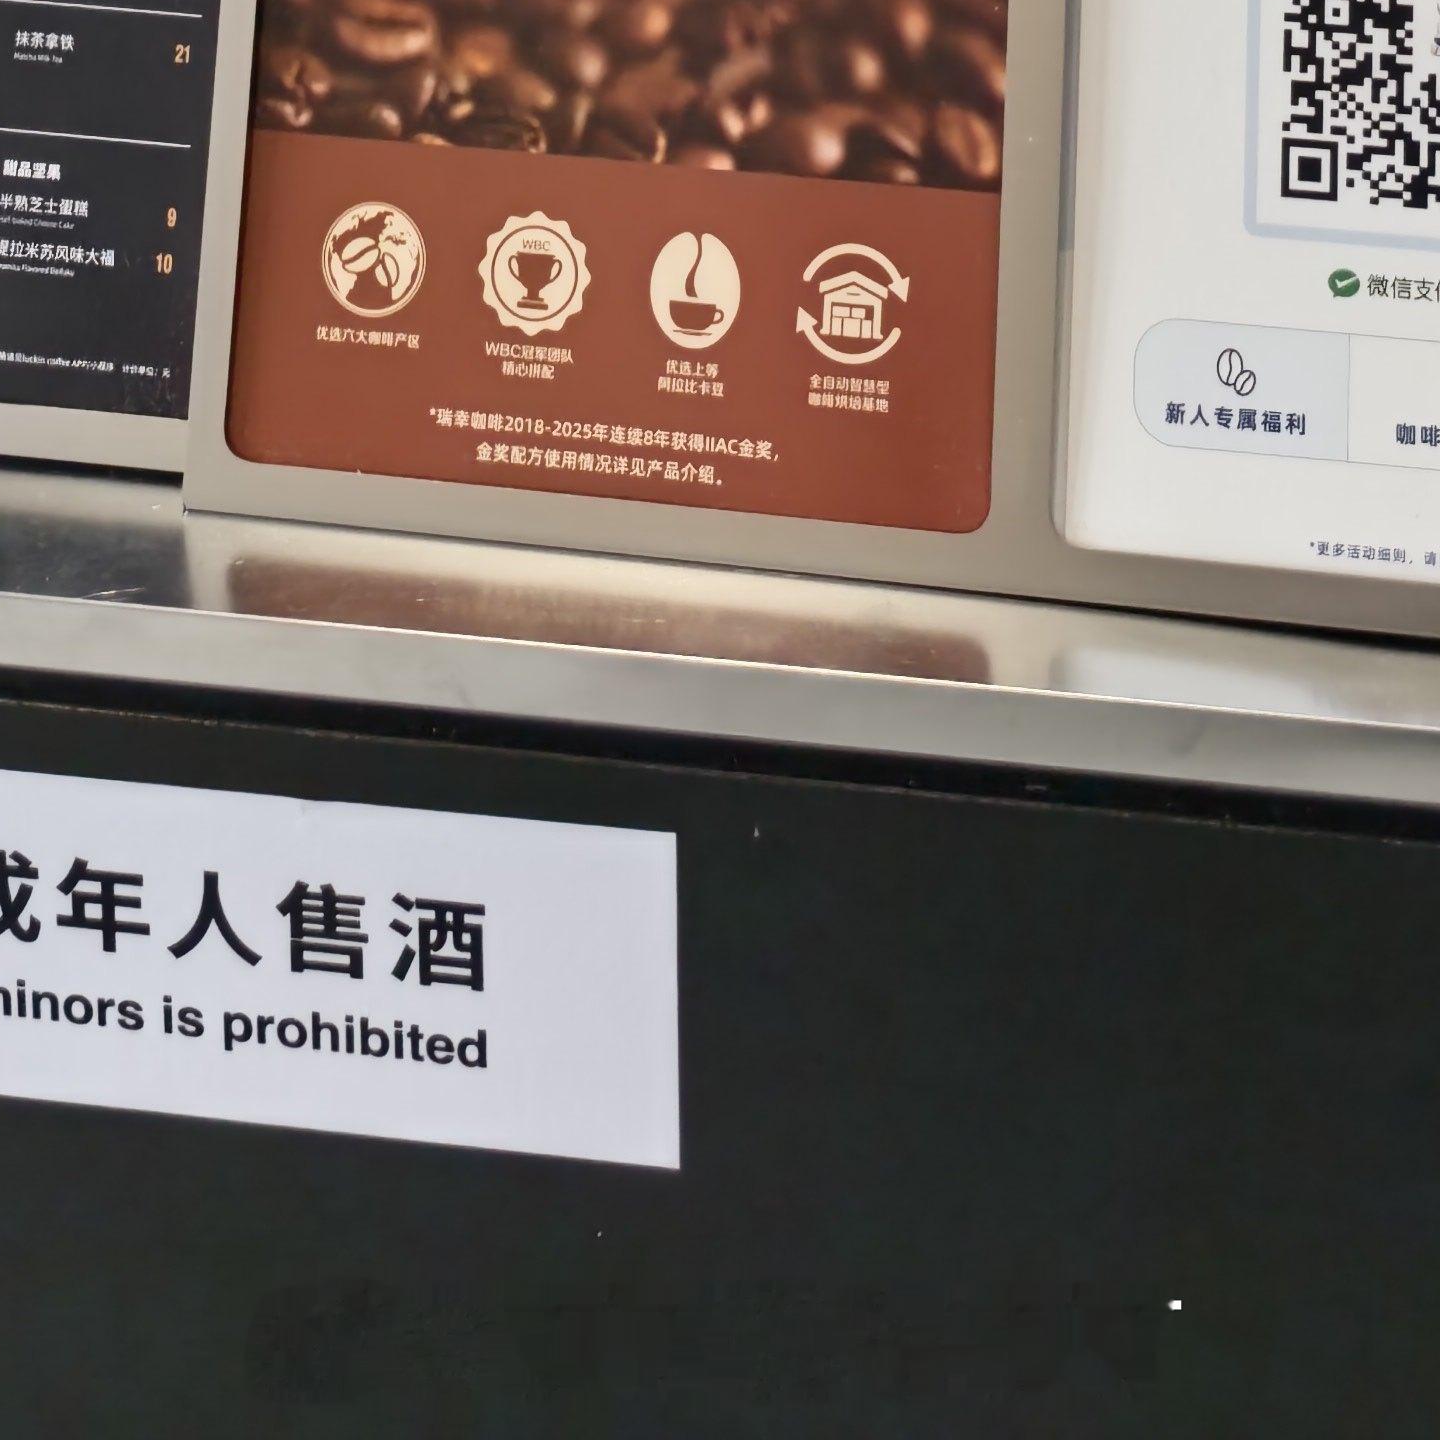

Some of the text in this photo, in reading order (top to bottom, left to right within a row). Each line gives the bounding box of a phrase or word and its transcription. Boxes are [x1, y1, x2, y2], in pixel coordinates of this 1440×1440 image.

[14, 29, 191, 65] 抹茶拿铁 21
[166, 206, 178, 228] 9
[521, 237, 552, 253] WBC
[155, 252, 174, 275] 10
[1165, 401, 1306, 436] 新人专属福利
[160, 992, 207, 1039] is
[221, 1006, 490, 1072] prohibited
